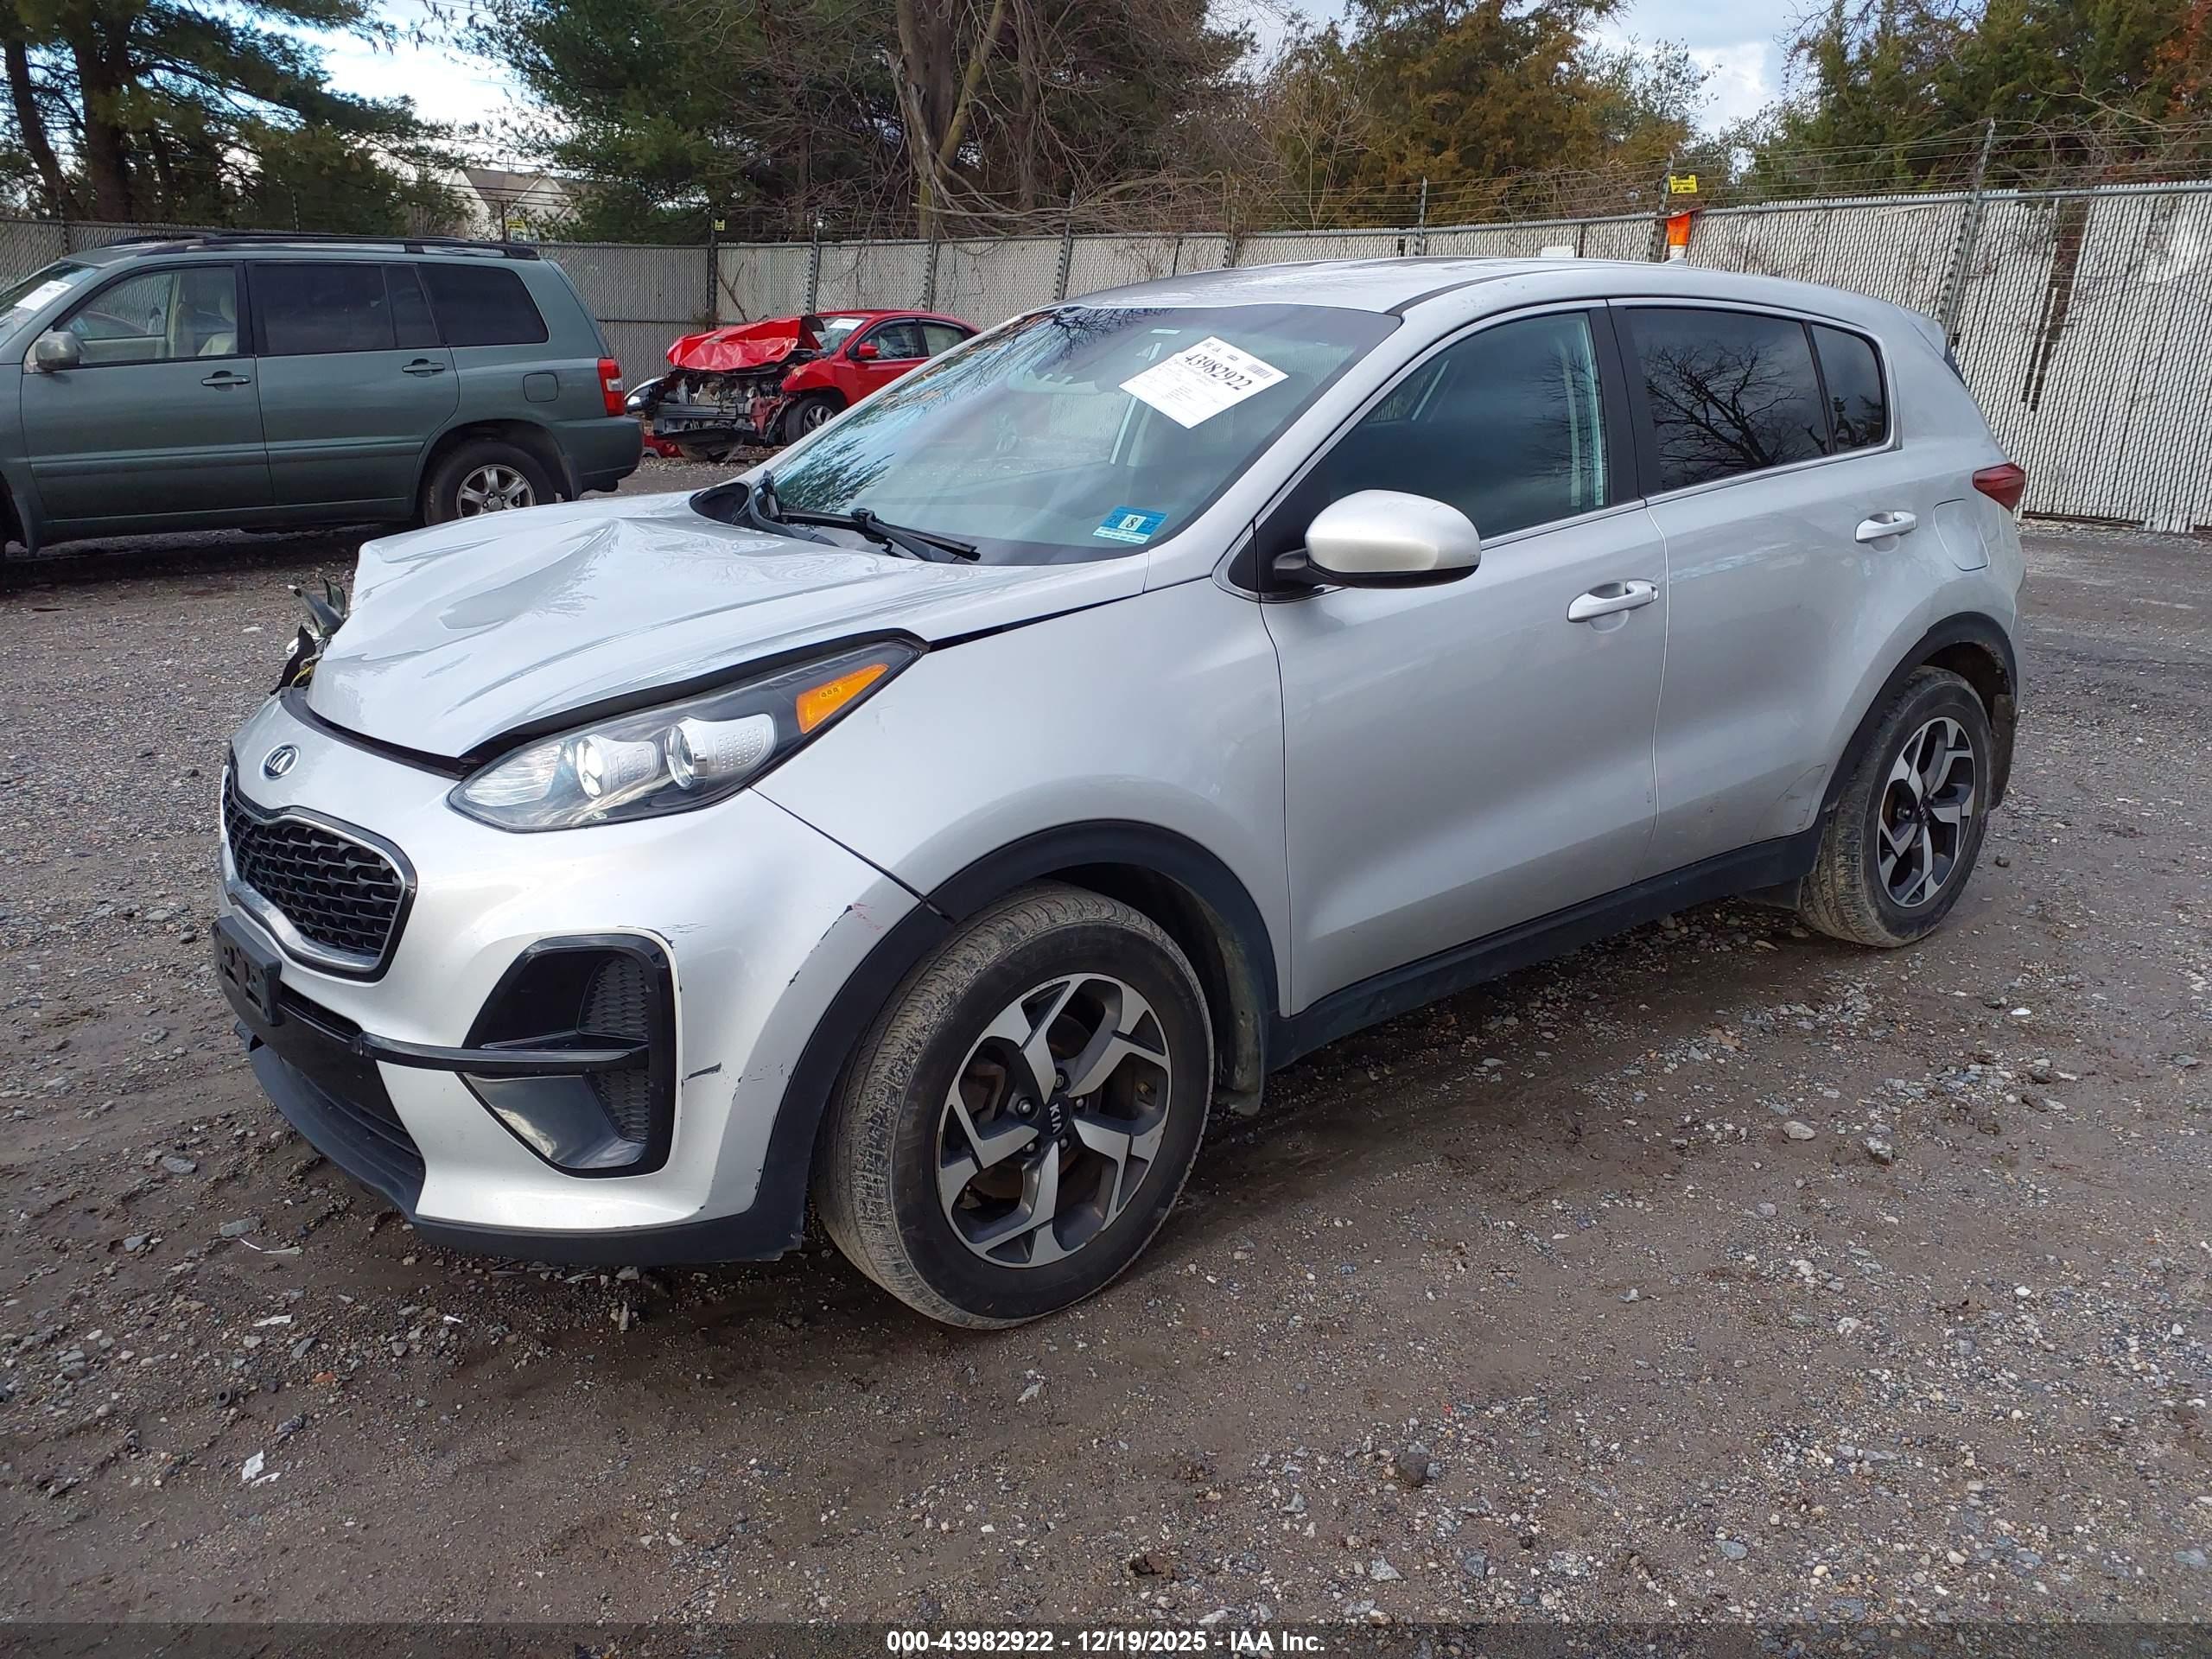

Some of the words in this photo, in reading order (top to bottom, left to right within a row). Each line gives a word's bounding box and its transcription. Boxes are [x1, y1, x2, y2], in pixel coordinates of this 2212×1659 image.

[1185, 353, 1253, 391] 43982922
[1125, 517, 1139, 529] 8
[1049, 1103, 1062, 1134] KIA
